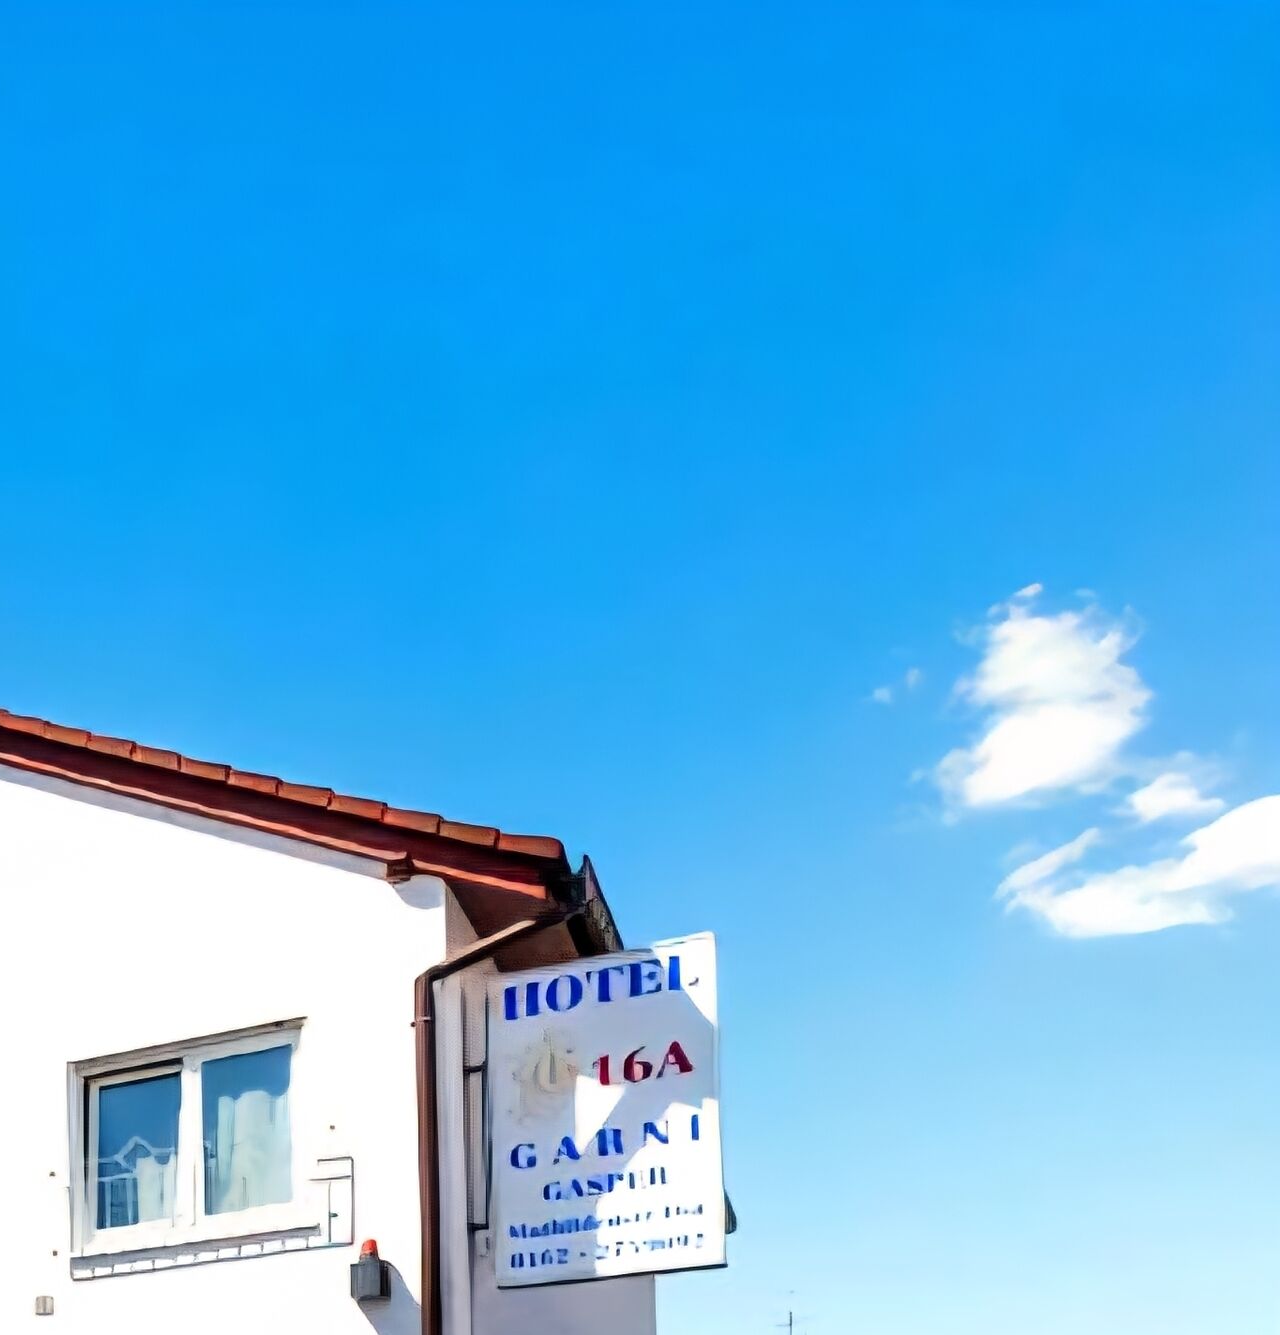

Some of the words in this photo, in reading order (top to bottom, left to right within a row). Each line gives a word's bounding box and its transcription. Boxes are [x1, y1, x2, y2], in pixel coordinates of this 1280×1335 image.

[503, 955, 700, 1021] HOTEL
[591, 1040, 695, 1086] 16A
[510, 1113, 700, 1169] GARNI
